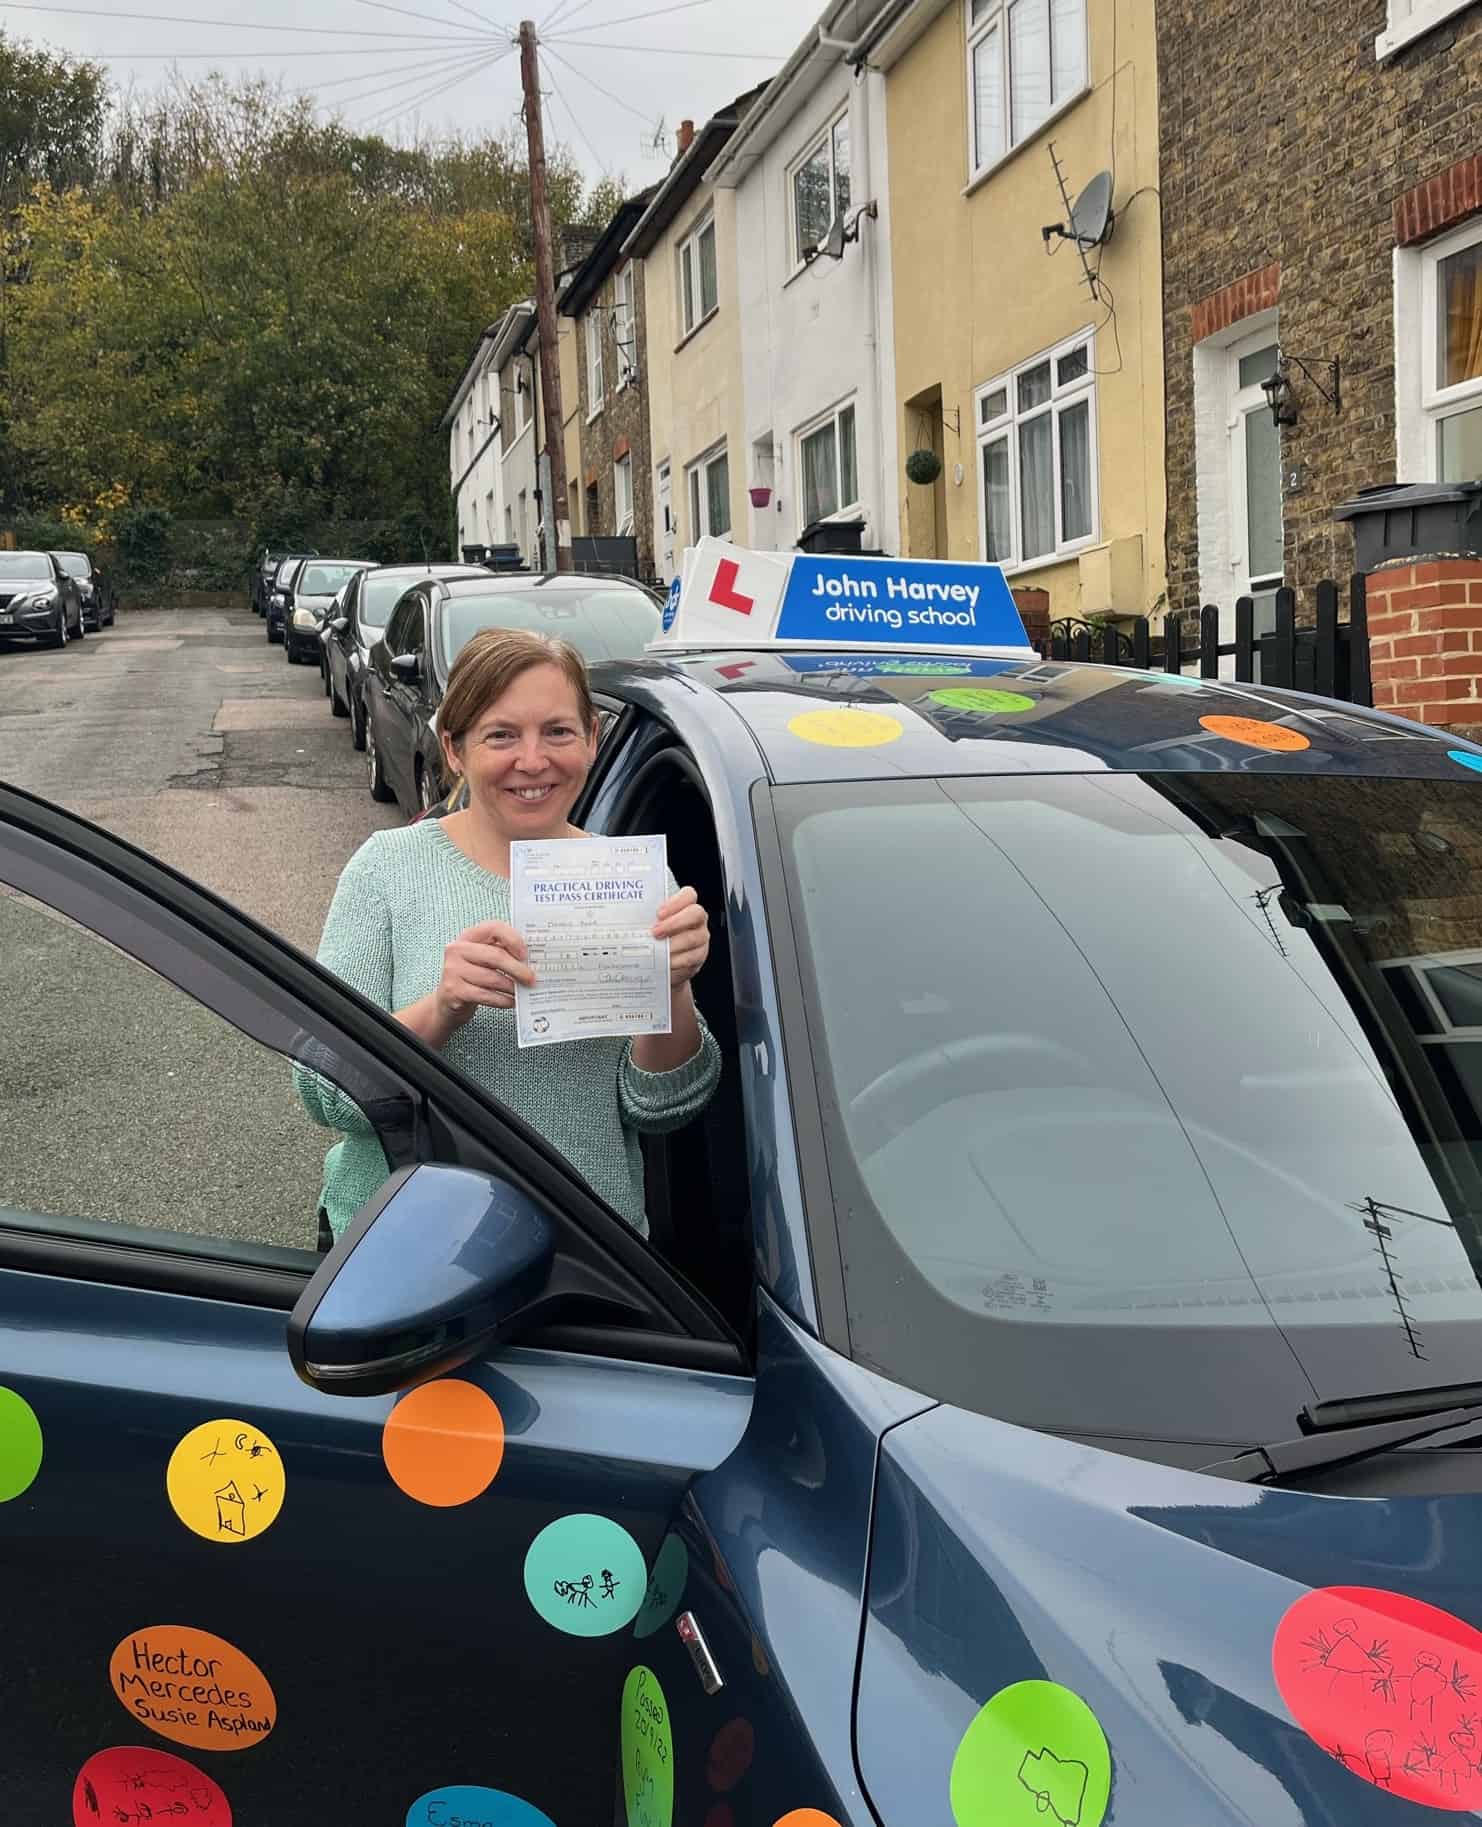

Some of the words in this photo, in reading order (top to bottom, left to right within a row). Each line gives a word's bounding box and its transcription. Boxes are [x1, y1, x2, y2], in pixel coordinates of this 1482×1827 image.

[1290, 471, 1297, 487] 2
[709, 558, 754, 615] L
[811, 573, 878, 598] John
[886, 577, 980, 608] Harvey
[825, 602, 903, 628] driving
[908, 606, 977, 627] school
[533, 880, 593, 893] PRACTICAL
[595, 879, 644, 891] DRIVING
[535, 893, 555, 902] TEST
[559, 892, 581, 901] PASS
[584, 889, 644, 901] CERTIFICATE
[132, 1639, 223, 1678] Hector
[119, 1672, 252, 1708] Mercedes
[134, 1698, 200, 1726] Susie
[208, 1710, 271, 1736] Aspland
